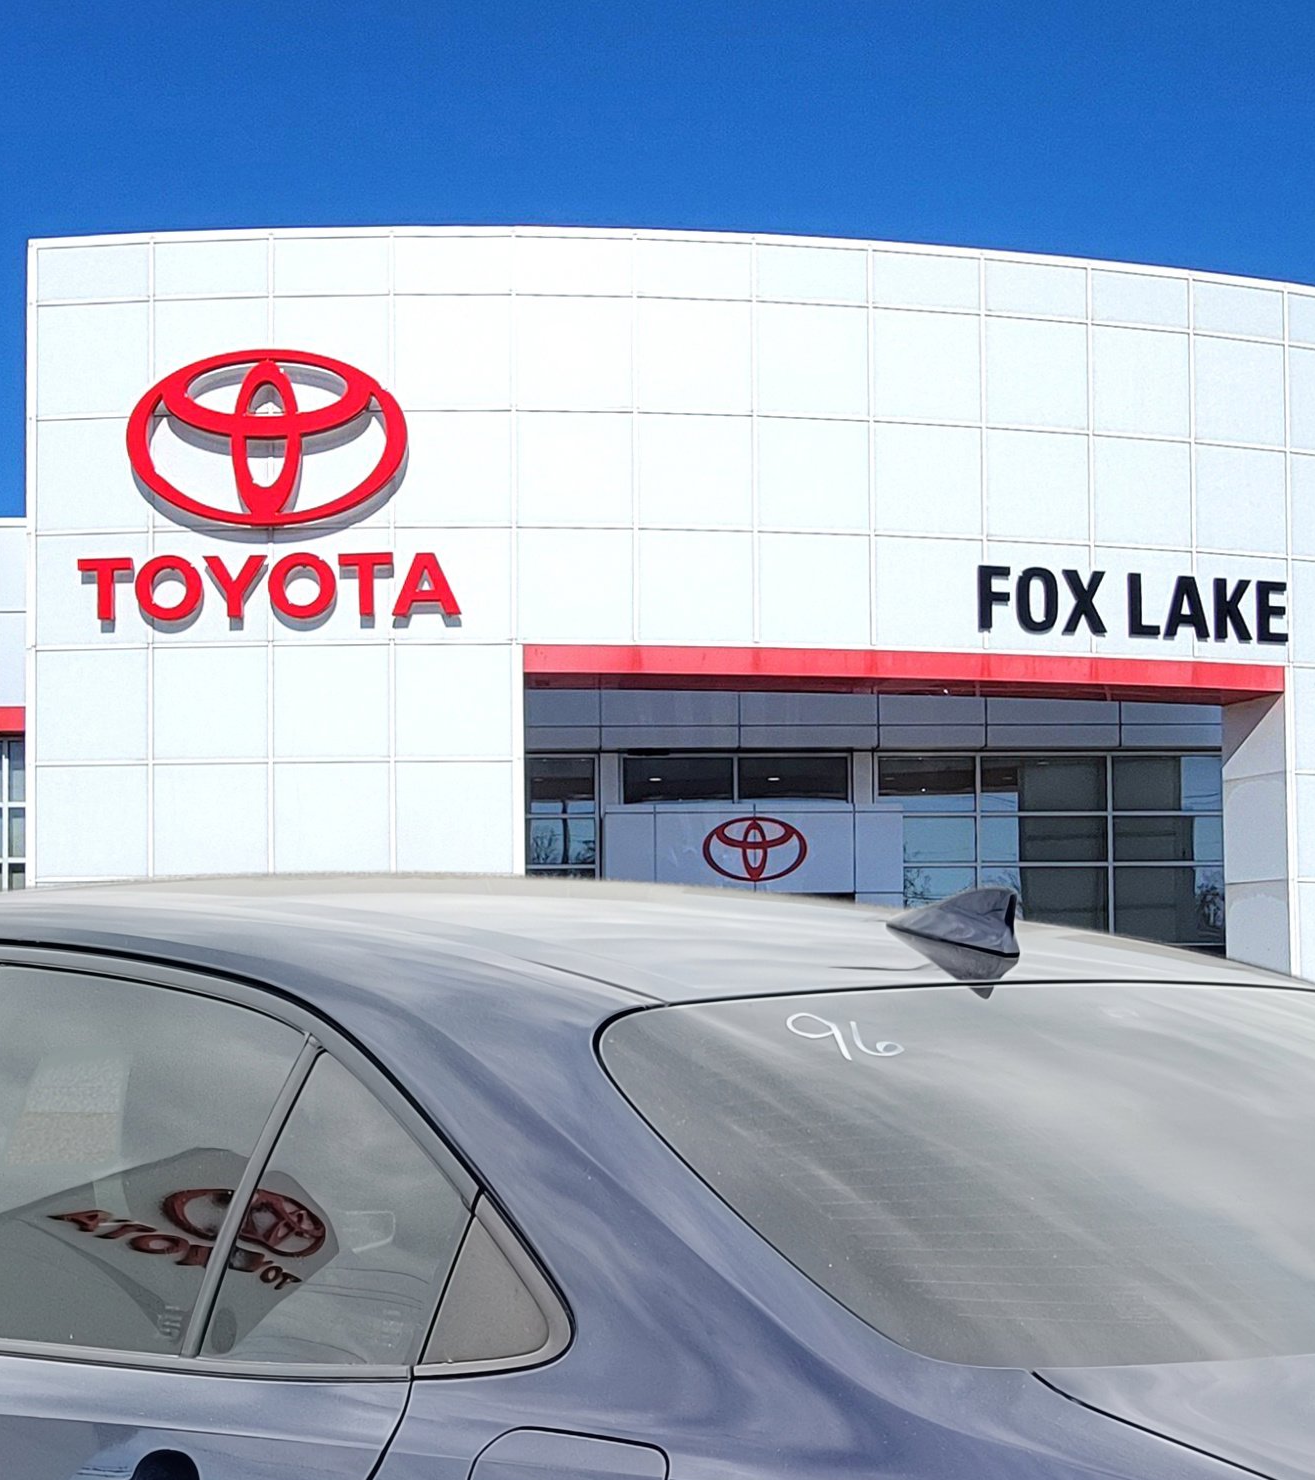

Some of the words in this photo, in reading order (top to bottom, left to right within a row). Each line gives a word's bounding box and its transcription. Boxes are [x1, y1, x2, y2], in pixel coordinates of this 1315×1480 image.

[77, 551, 462, 628] TOYOTA
[978, 564, 1108, 636] FOX
[1127, 572, 1290, 644] LAKE
[786, 1012, 905, 1061] 96
